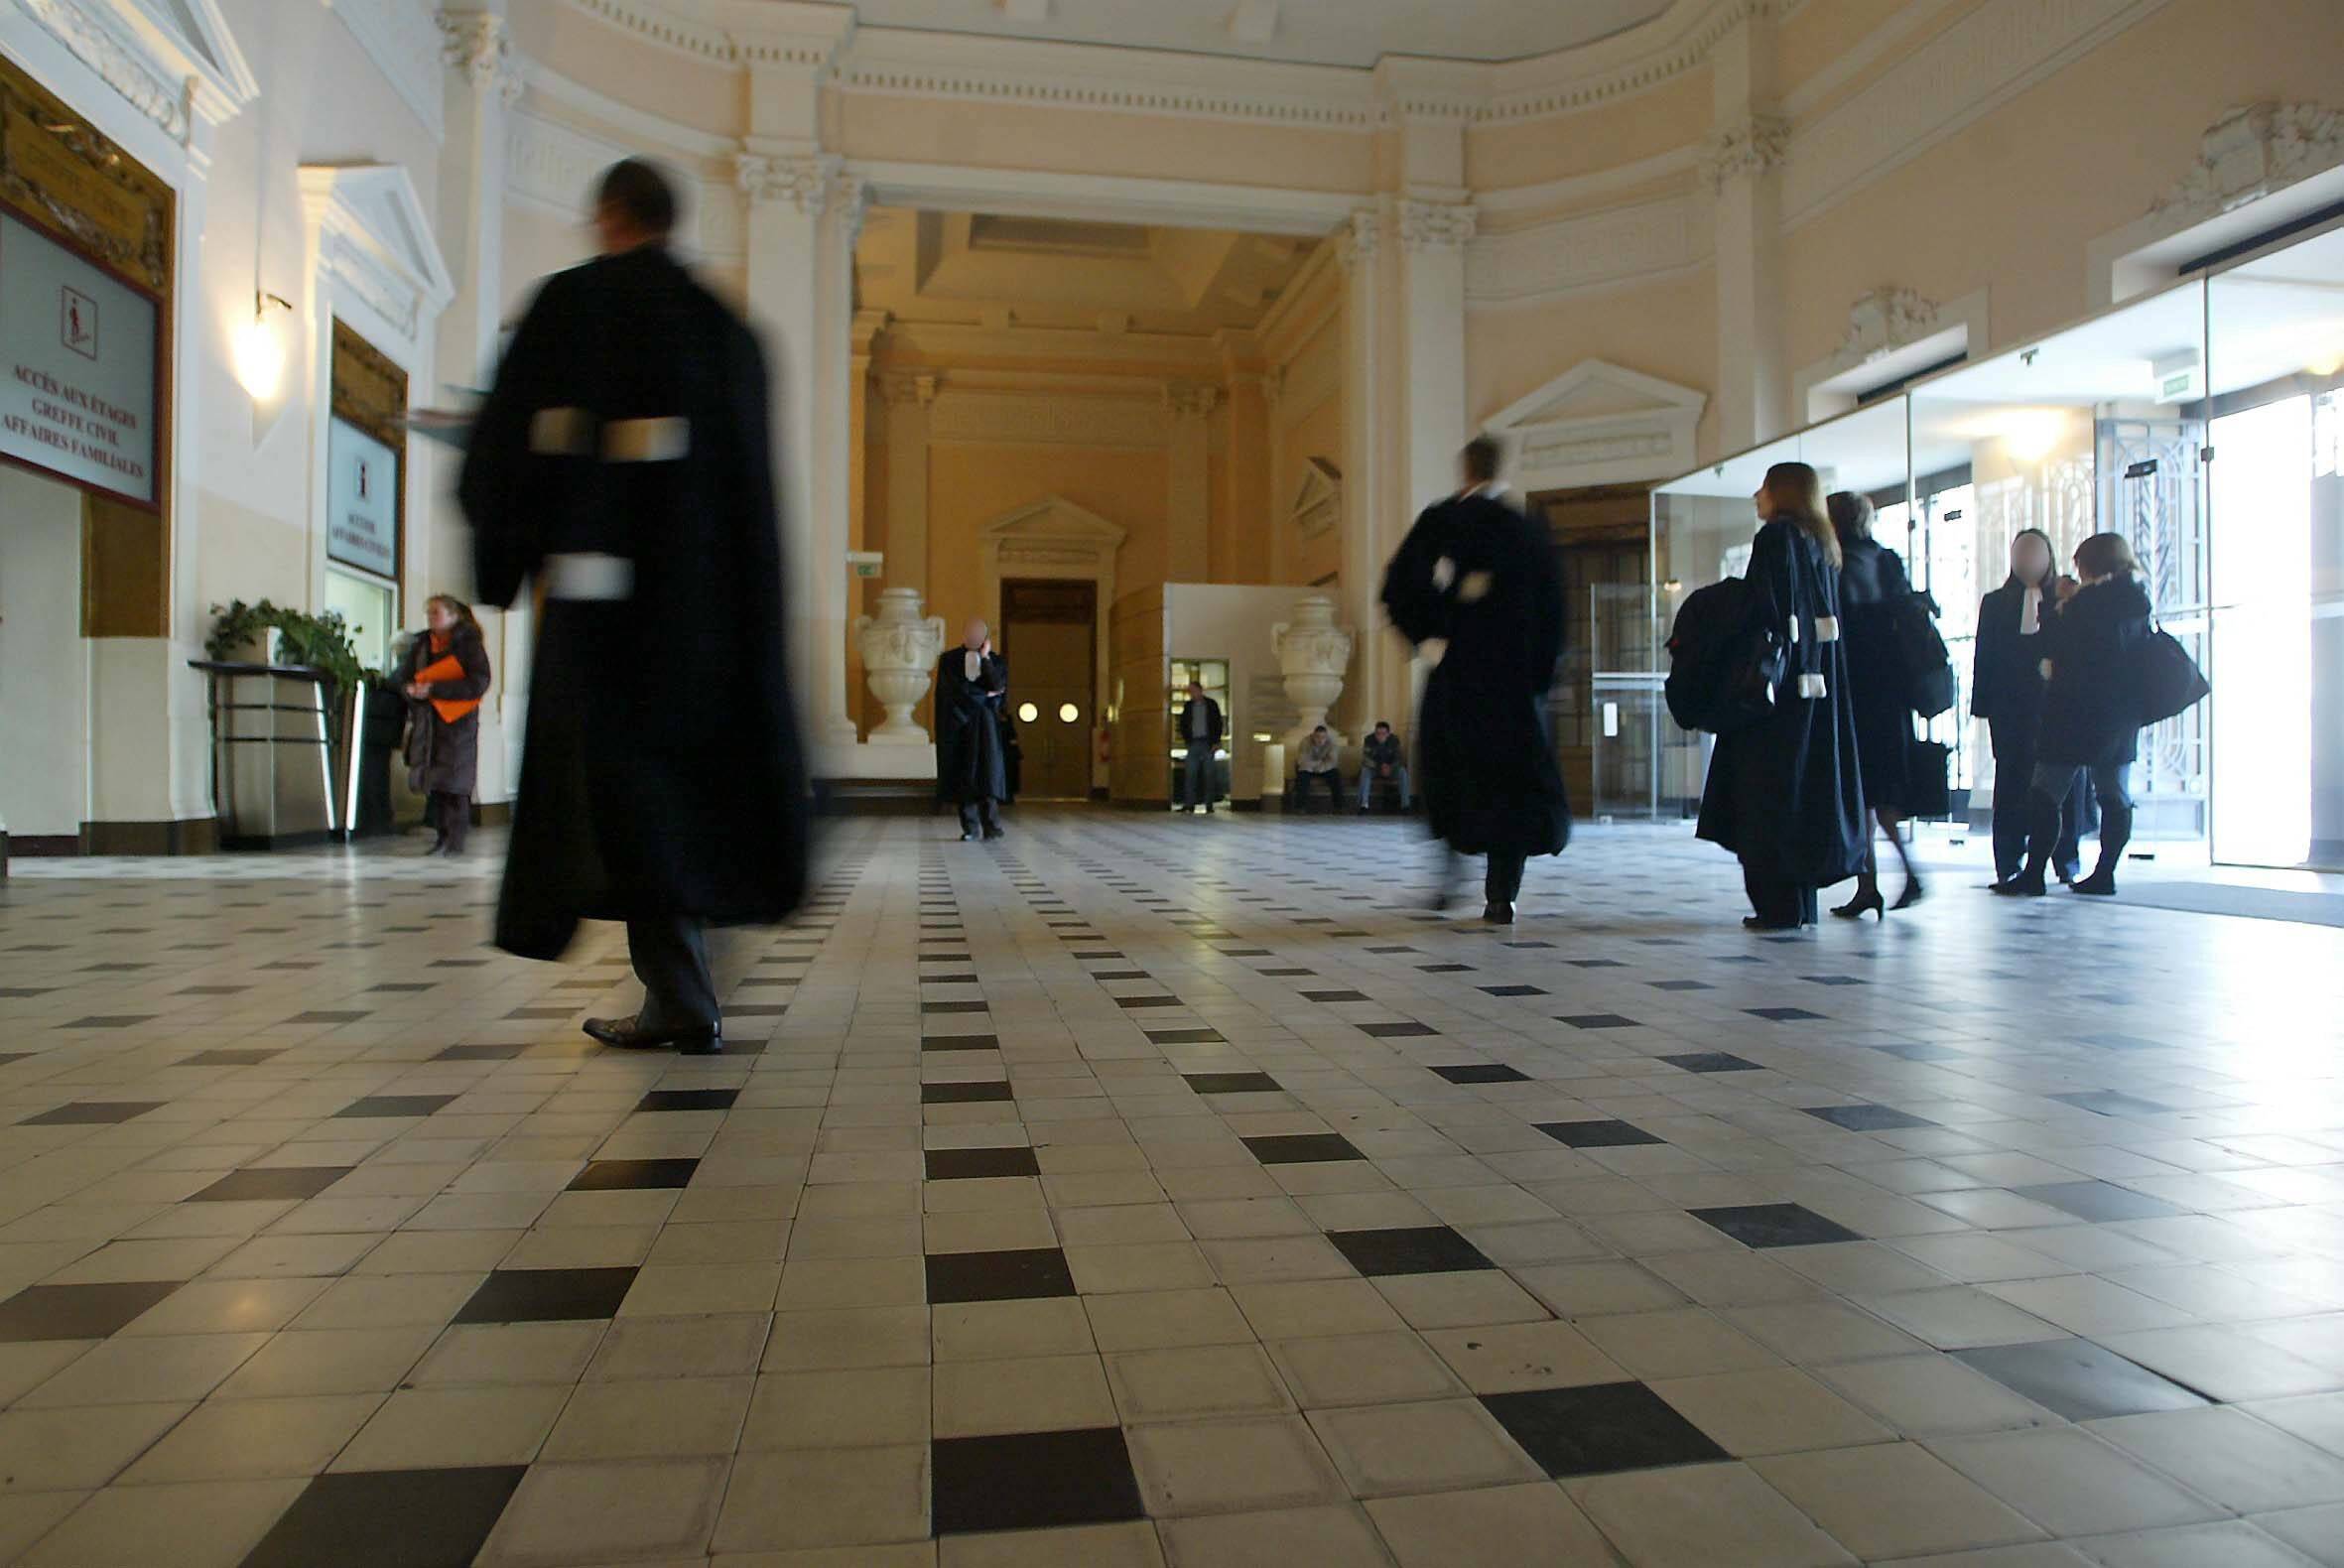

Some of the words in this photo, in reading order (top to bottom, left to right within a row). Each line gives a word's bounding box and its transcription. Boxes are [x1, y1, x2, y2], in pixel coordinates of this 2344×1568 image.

[14, 364, 60, 396] ACCÈS
[63, 385, 88, 410] AUX
[2, 413, 68, 450] AFFAIRES
[32, 396, 83, 433] GREFFE
[86, 420, 120, 448] CIVIL
